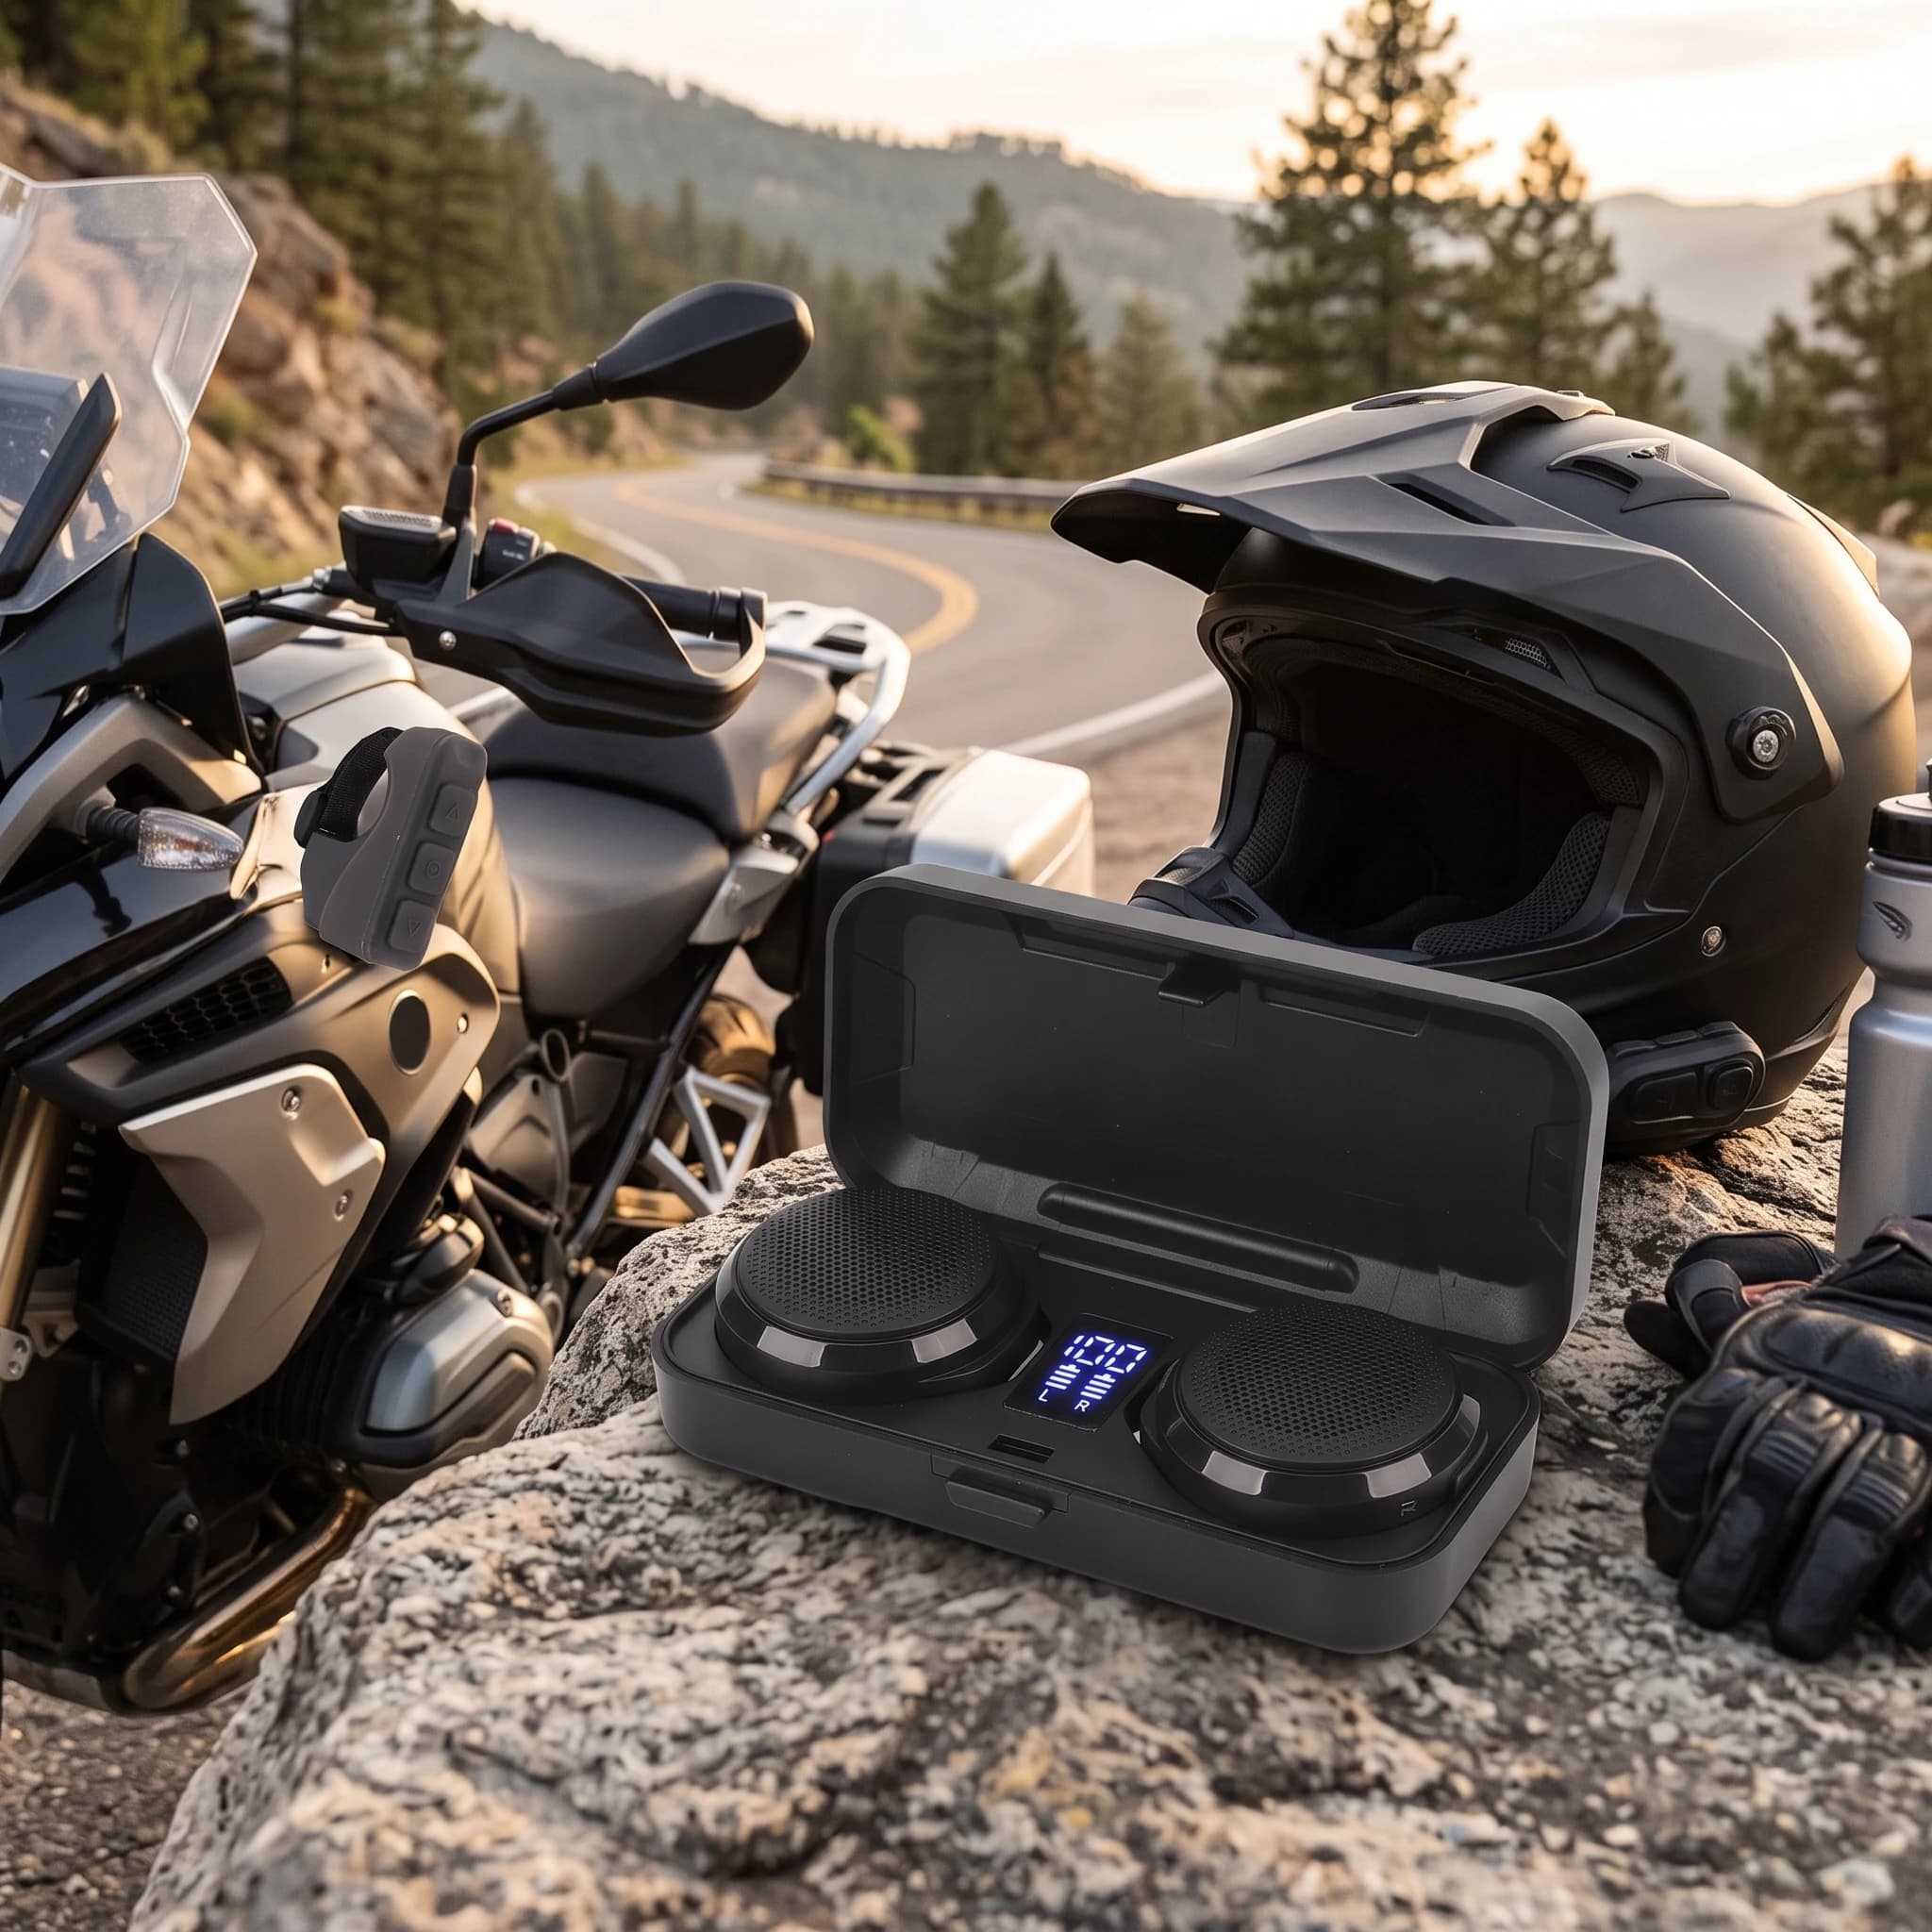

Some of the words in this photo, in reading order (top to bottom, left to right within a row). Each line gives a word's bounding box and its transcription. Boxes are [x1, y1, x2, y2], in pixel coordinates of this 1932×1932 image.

[1063, 1335, 1148, 1374] 100
[1038, 1388, 1049, 1403] L
[1074, 1399, 1091, 1412] R
